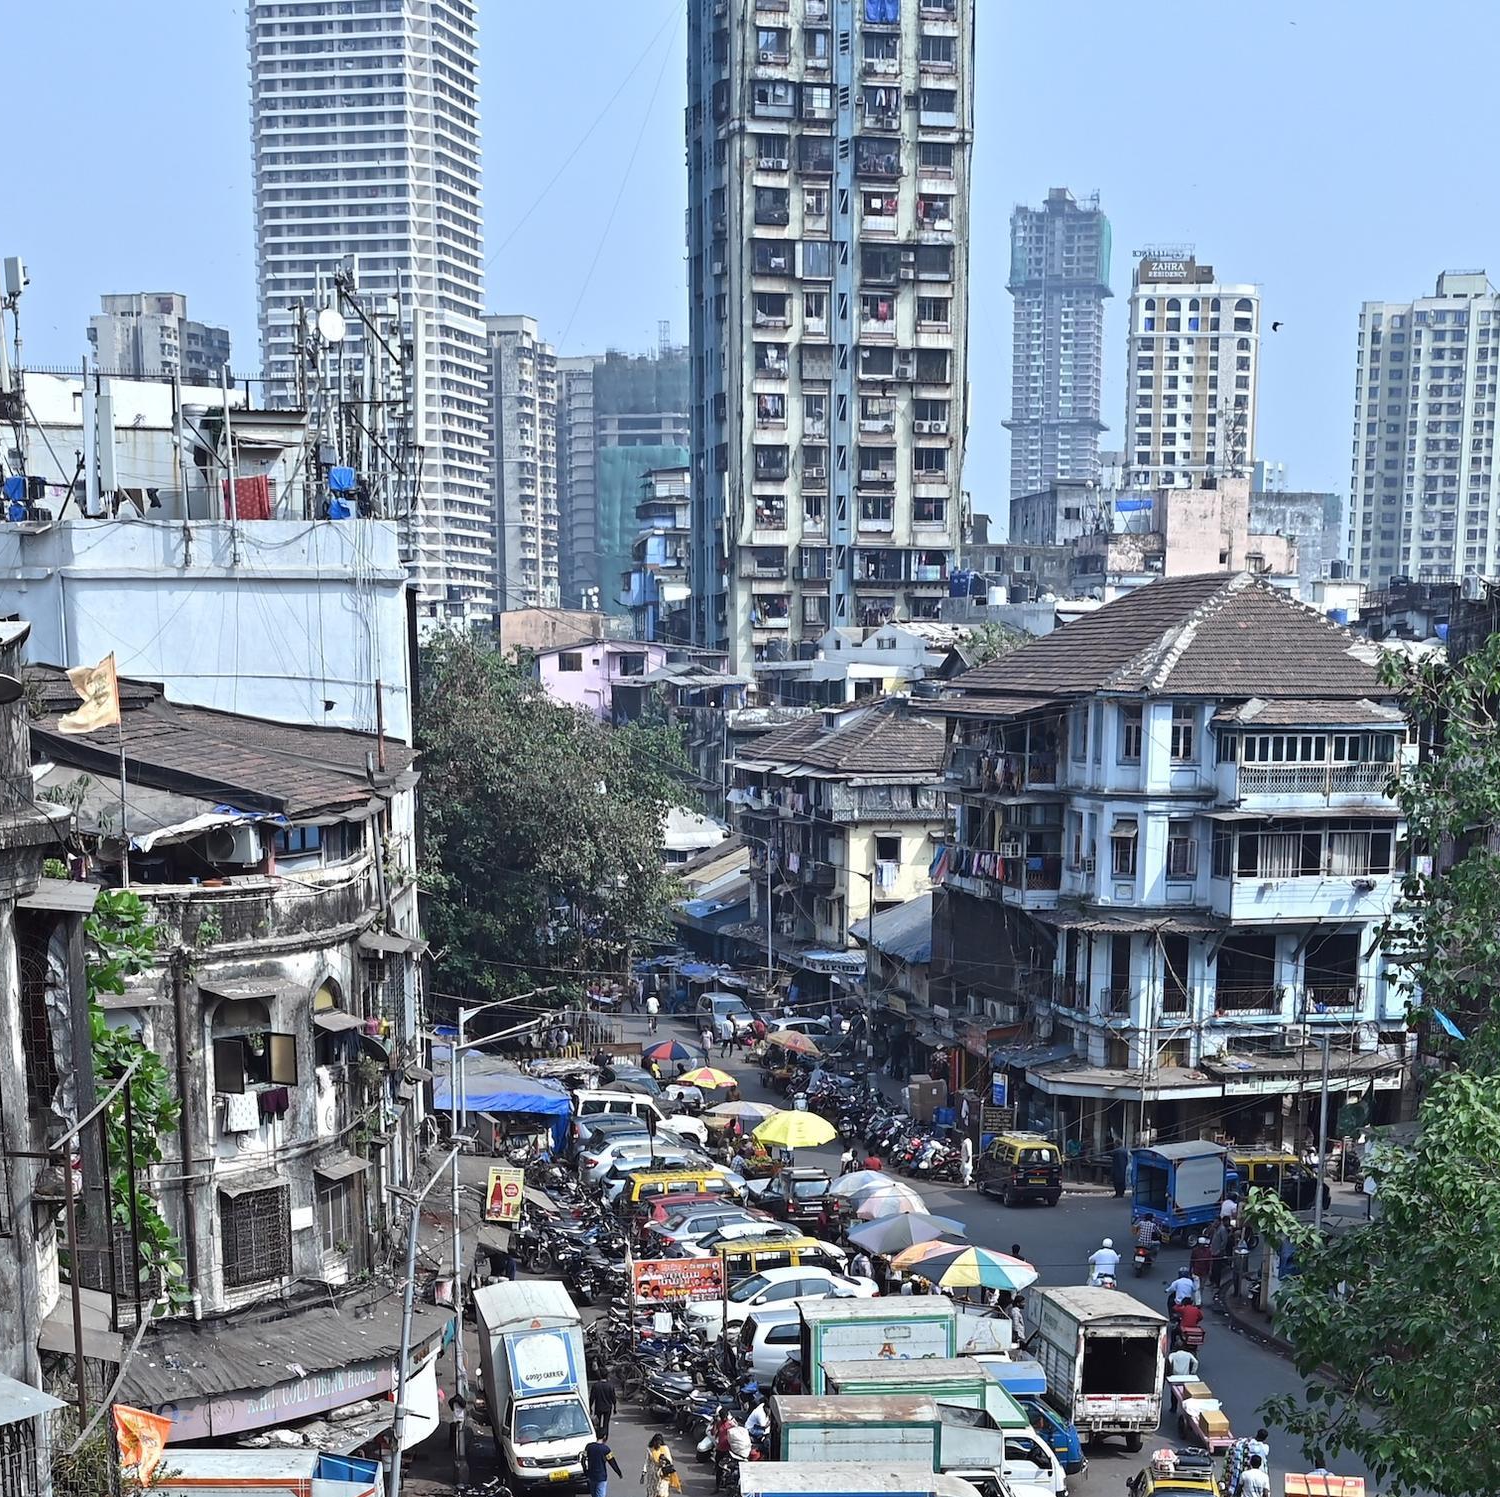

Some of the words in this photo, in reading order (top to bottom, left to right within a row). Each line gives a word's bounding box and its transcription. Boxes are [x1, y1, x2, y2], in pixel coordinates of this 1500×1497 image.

[1151, 262, 1185, 271] ZAHRA
[525, 1373, 542, 1383] GOODS
[543, 1370, 565, 1379] CARRIER
[282, 1379, 310, 1406] COLD
[314, 1371, 345, 1398] DRINK
[347, 1368, 377, 1389] HOUSE
